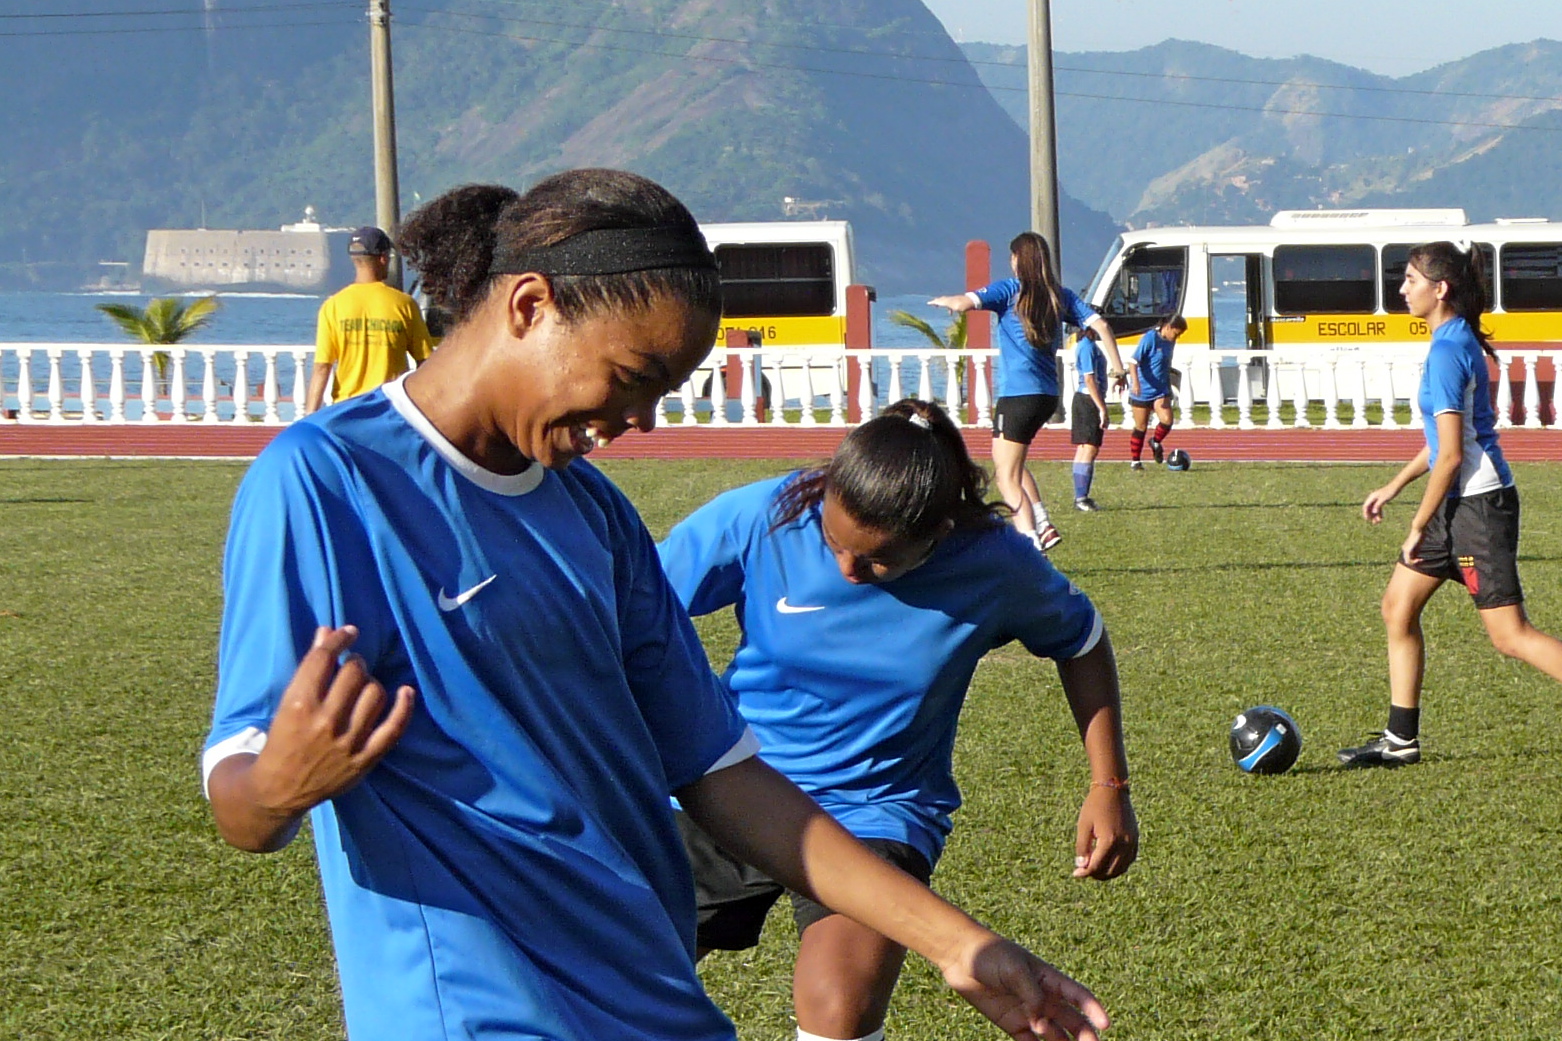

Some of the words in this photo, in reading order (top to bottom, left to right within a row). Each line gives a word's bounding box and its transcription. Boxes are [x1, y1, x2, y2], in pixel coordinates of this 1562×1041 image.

[340, 318, 362, 331] TEAM
[1318, 321, 1386, 336] ESCOLAR
[1409, 321, 1432, 335] 05
